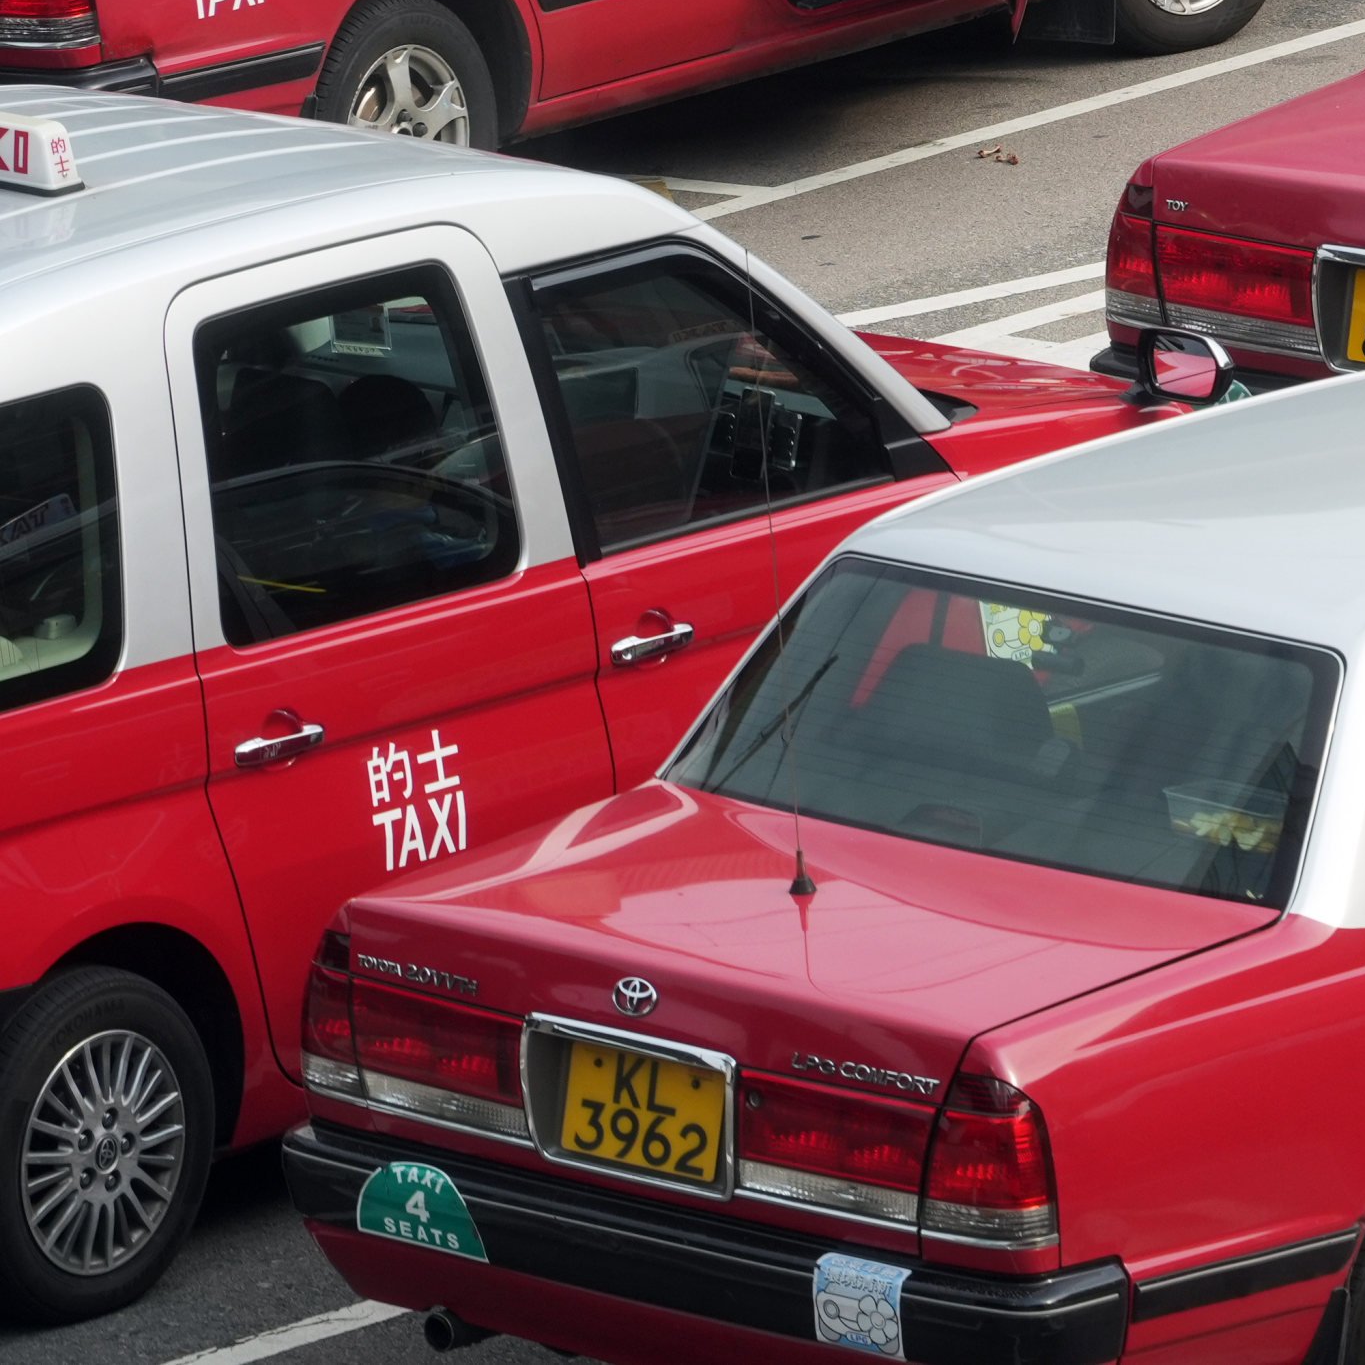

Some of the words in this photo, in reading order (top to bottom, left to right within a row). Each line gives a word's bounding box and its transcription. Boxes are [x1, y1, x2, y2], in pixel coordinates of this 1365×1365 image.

[50, 136, 70, 176] 的士
[366, 729, 461, 808] 的士
[372, 790, 467, 871] TAXI
[358, 954, 403, 977] TOYOTA
[613, 1051, 677, 1118] KL
[791, 1051, 835, 1075] LPG
[840, 1061, 941, 1096] COMFORT
[573, 1098, 708, 1178] 3962
[391, 1165, 445, 1194] TAXI
[405, 1190, 430, 1223] 4
[383, 1217, 459, 1250] SEATS
